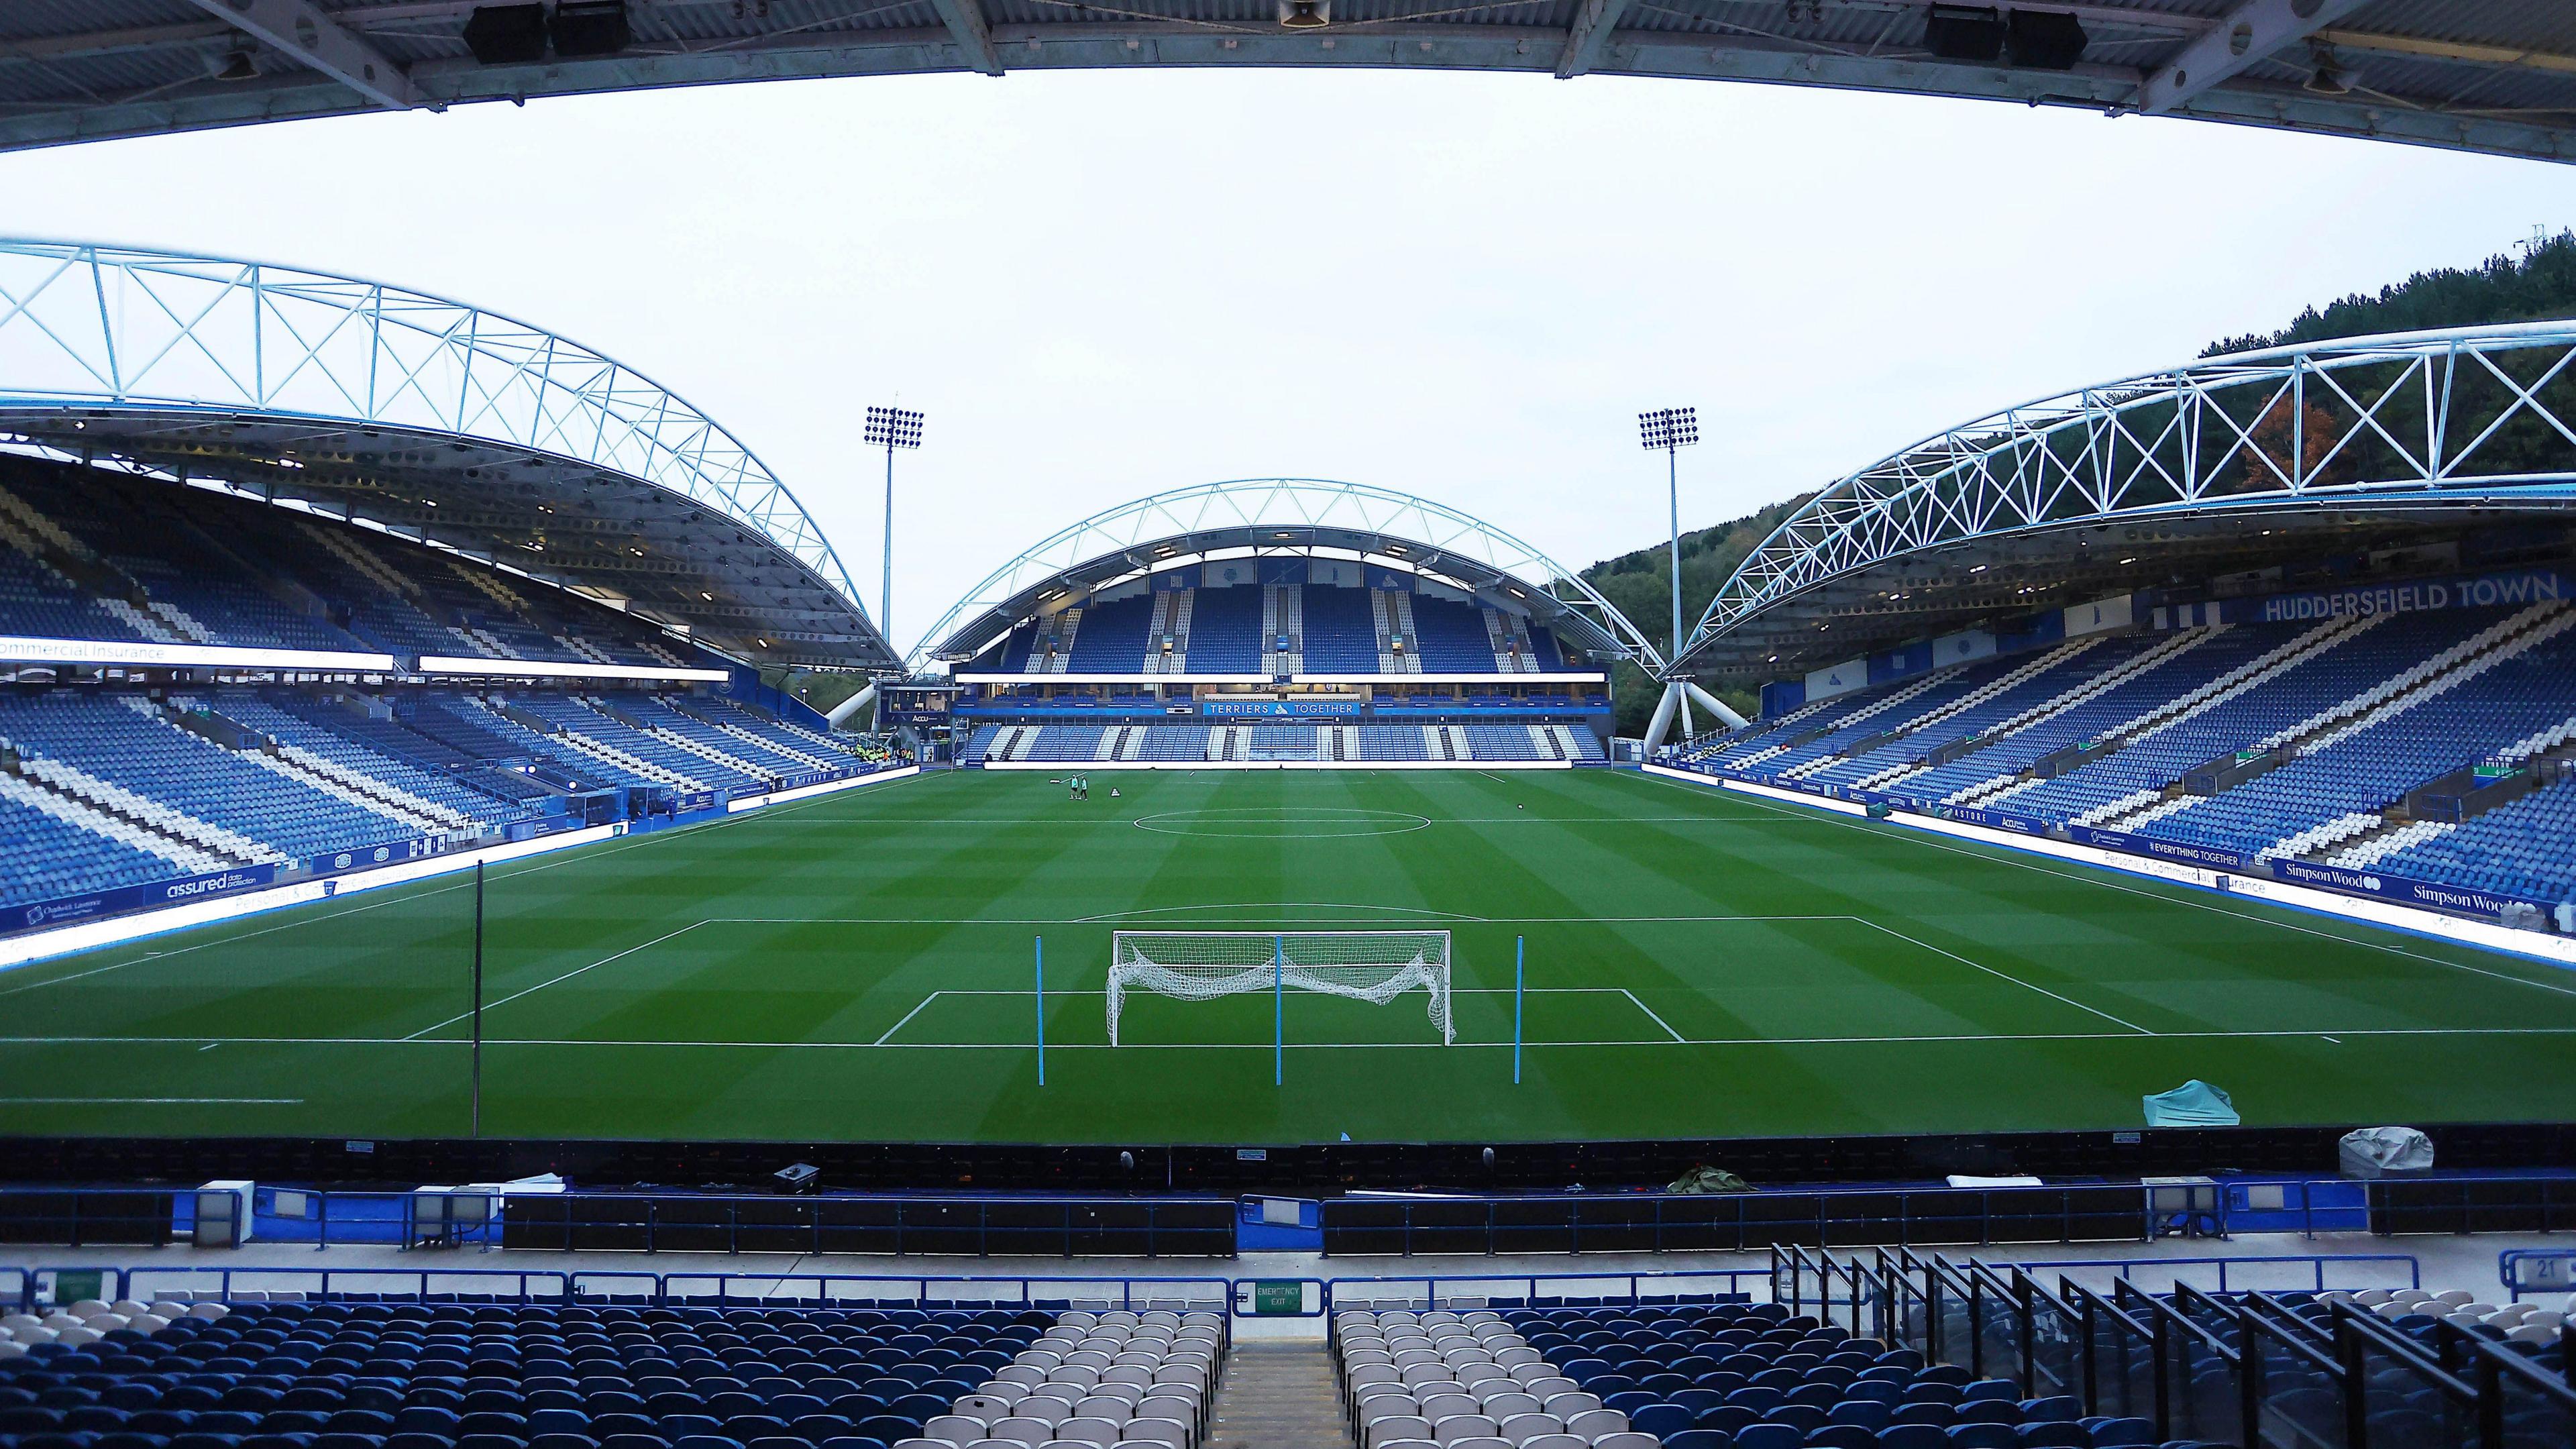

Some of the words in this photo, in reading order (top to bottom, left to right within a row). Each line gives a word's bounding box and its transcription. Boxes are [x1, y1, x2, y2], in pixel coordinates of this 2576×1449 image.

[2265, 584, 2448, 622] HUDDERSFIELD
[2457, 575, 2559, 606] TOWN
[93, 643, 165, 659] Insurance
[1210, 704, 1269, 714] TERRIERS
[1294, 704, 1352, 714] TOGETHER
[1949, 808, 1986, 822] ASTORE
[2155, 843, 2199, 859] EVERYTHING
[2200, 850, 2238, 866] TOGETHER
[2256, 855, 2263, 864] 26
[228, 874, 243, 882] data
[2104, 852, 2141, 866] Personal
[2143, 859, 2149, 870] &
[2152, 861, 2210, 883] Commercal
[2213, 873, 2265, 894] Iurance
[2286, 863, 2330, 881] Simpson
[2330, 871, 2363, 888] Wood
[167, 873, 227, 898] assured
[227, 877, 256, 889] protection
[235, 889, 290, 910] Personal
[293, 886, 301, 900] &
[2414, 885, 2471, 907] Simpson
[2471, 894, 2512, 913] Woo
[2537, 1260, 2555, 1278] 21
[1257, 1287, 1300, 1295] EMERENCY
